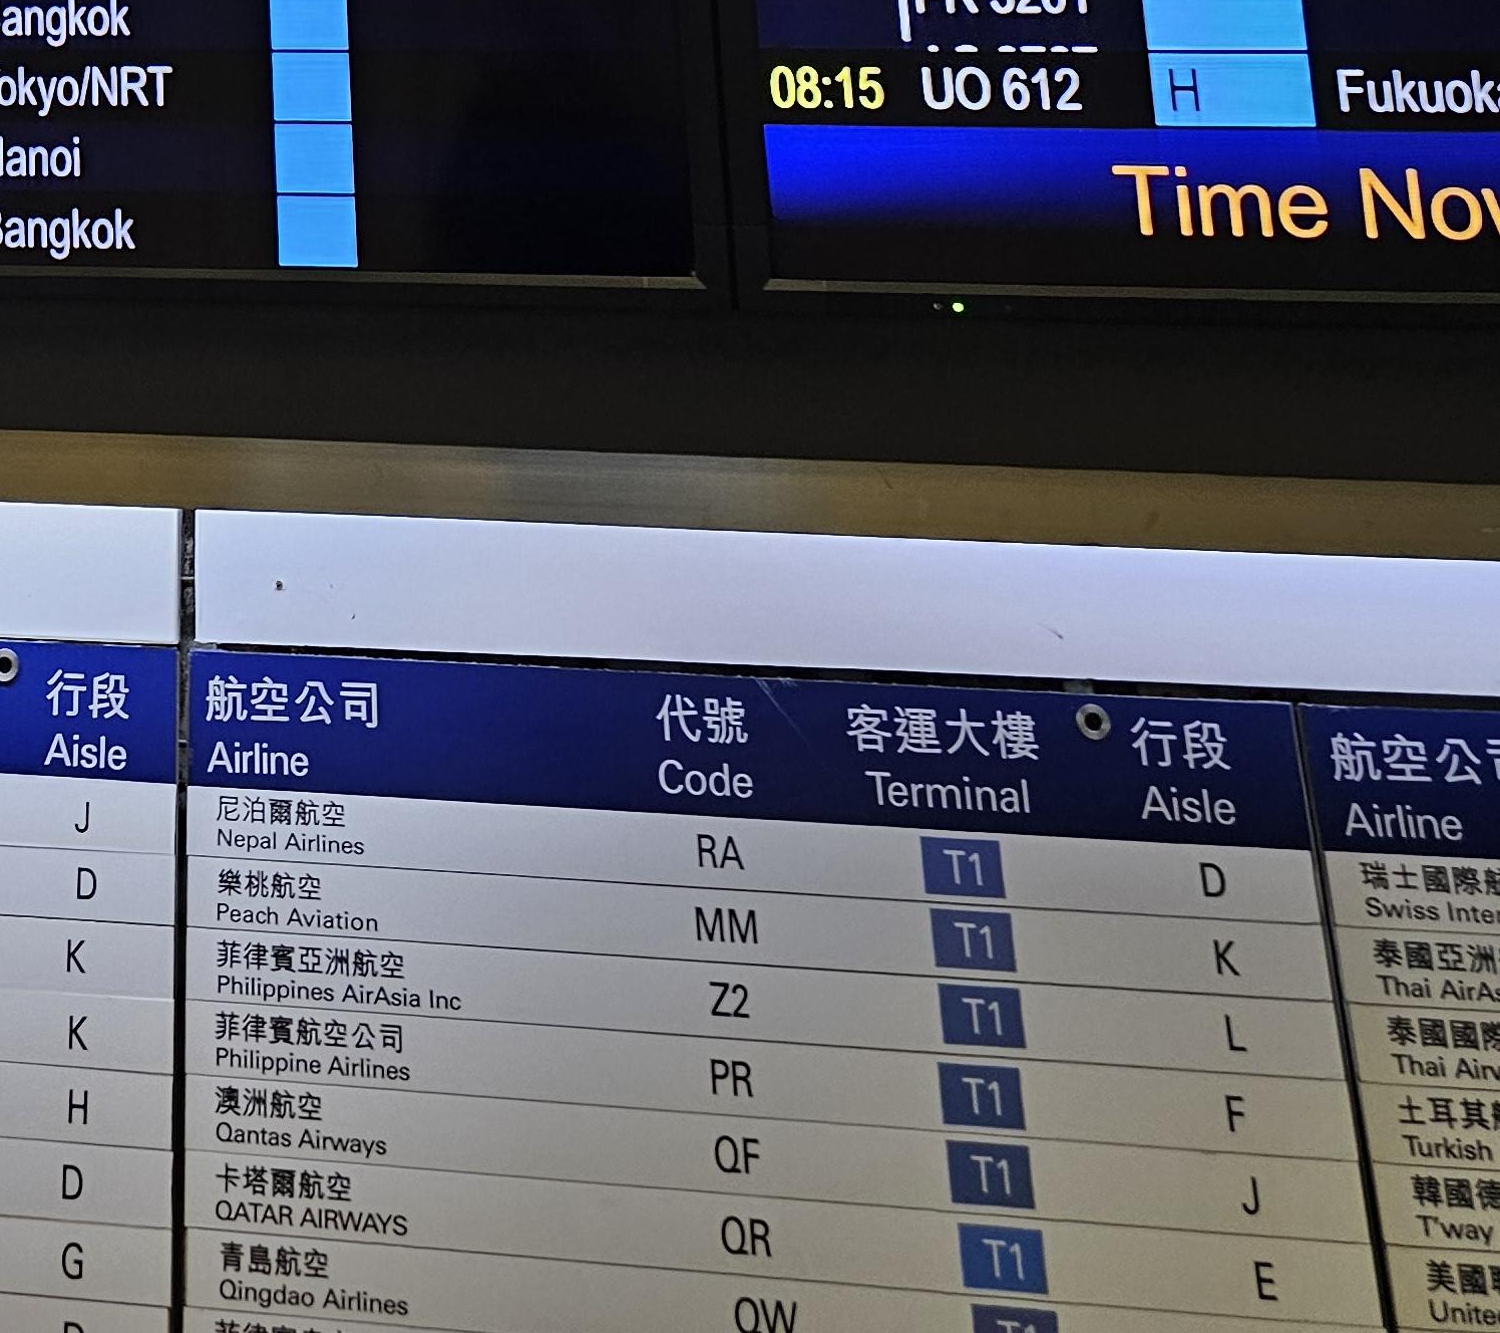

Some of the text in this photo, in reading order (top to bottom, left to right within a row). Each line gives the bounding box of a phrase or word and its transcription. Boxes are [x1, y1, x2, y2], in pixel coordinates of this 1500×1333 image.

[769, 65, 1201, 112] 08:15 UO 612 H
[1111, 164, 1329, 239] Time
[205, 674, 378, 729] 航空公司
[655, 693, 749, 745] 代號
[846, 703, 1040, 761] 客運大樓
[1130, 716, 1232, 771] 行段
[206, 741, 310, 777] Airline
[658, 759, 753, 799] Code
[216, 795, 346, 828] 尼泊爾航空
[864, 770, 1031, 814] Terminal
[1141, 785, 1236, 825] Aisle
[74, 801, 90, 834] J
[217, 828, 365, 855] Nepal Airlines
[696, 833, 745, 871] RA
[942, 848, 1227, 898] T1 D
[215, 1121, 388, 1159] Qantas Airways
[714, 1134, 760, 1175] QF
[215, 1199, 408, 1237] QATAR AIRWAYS
[721, 1215, 773, 1258] QR
